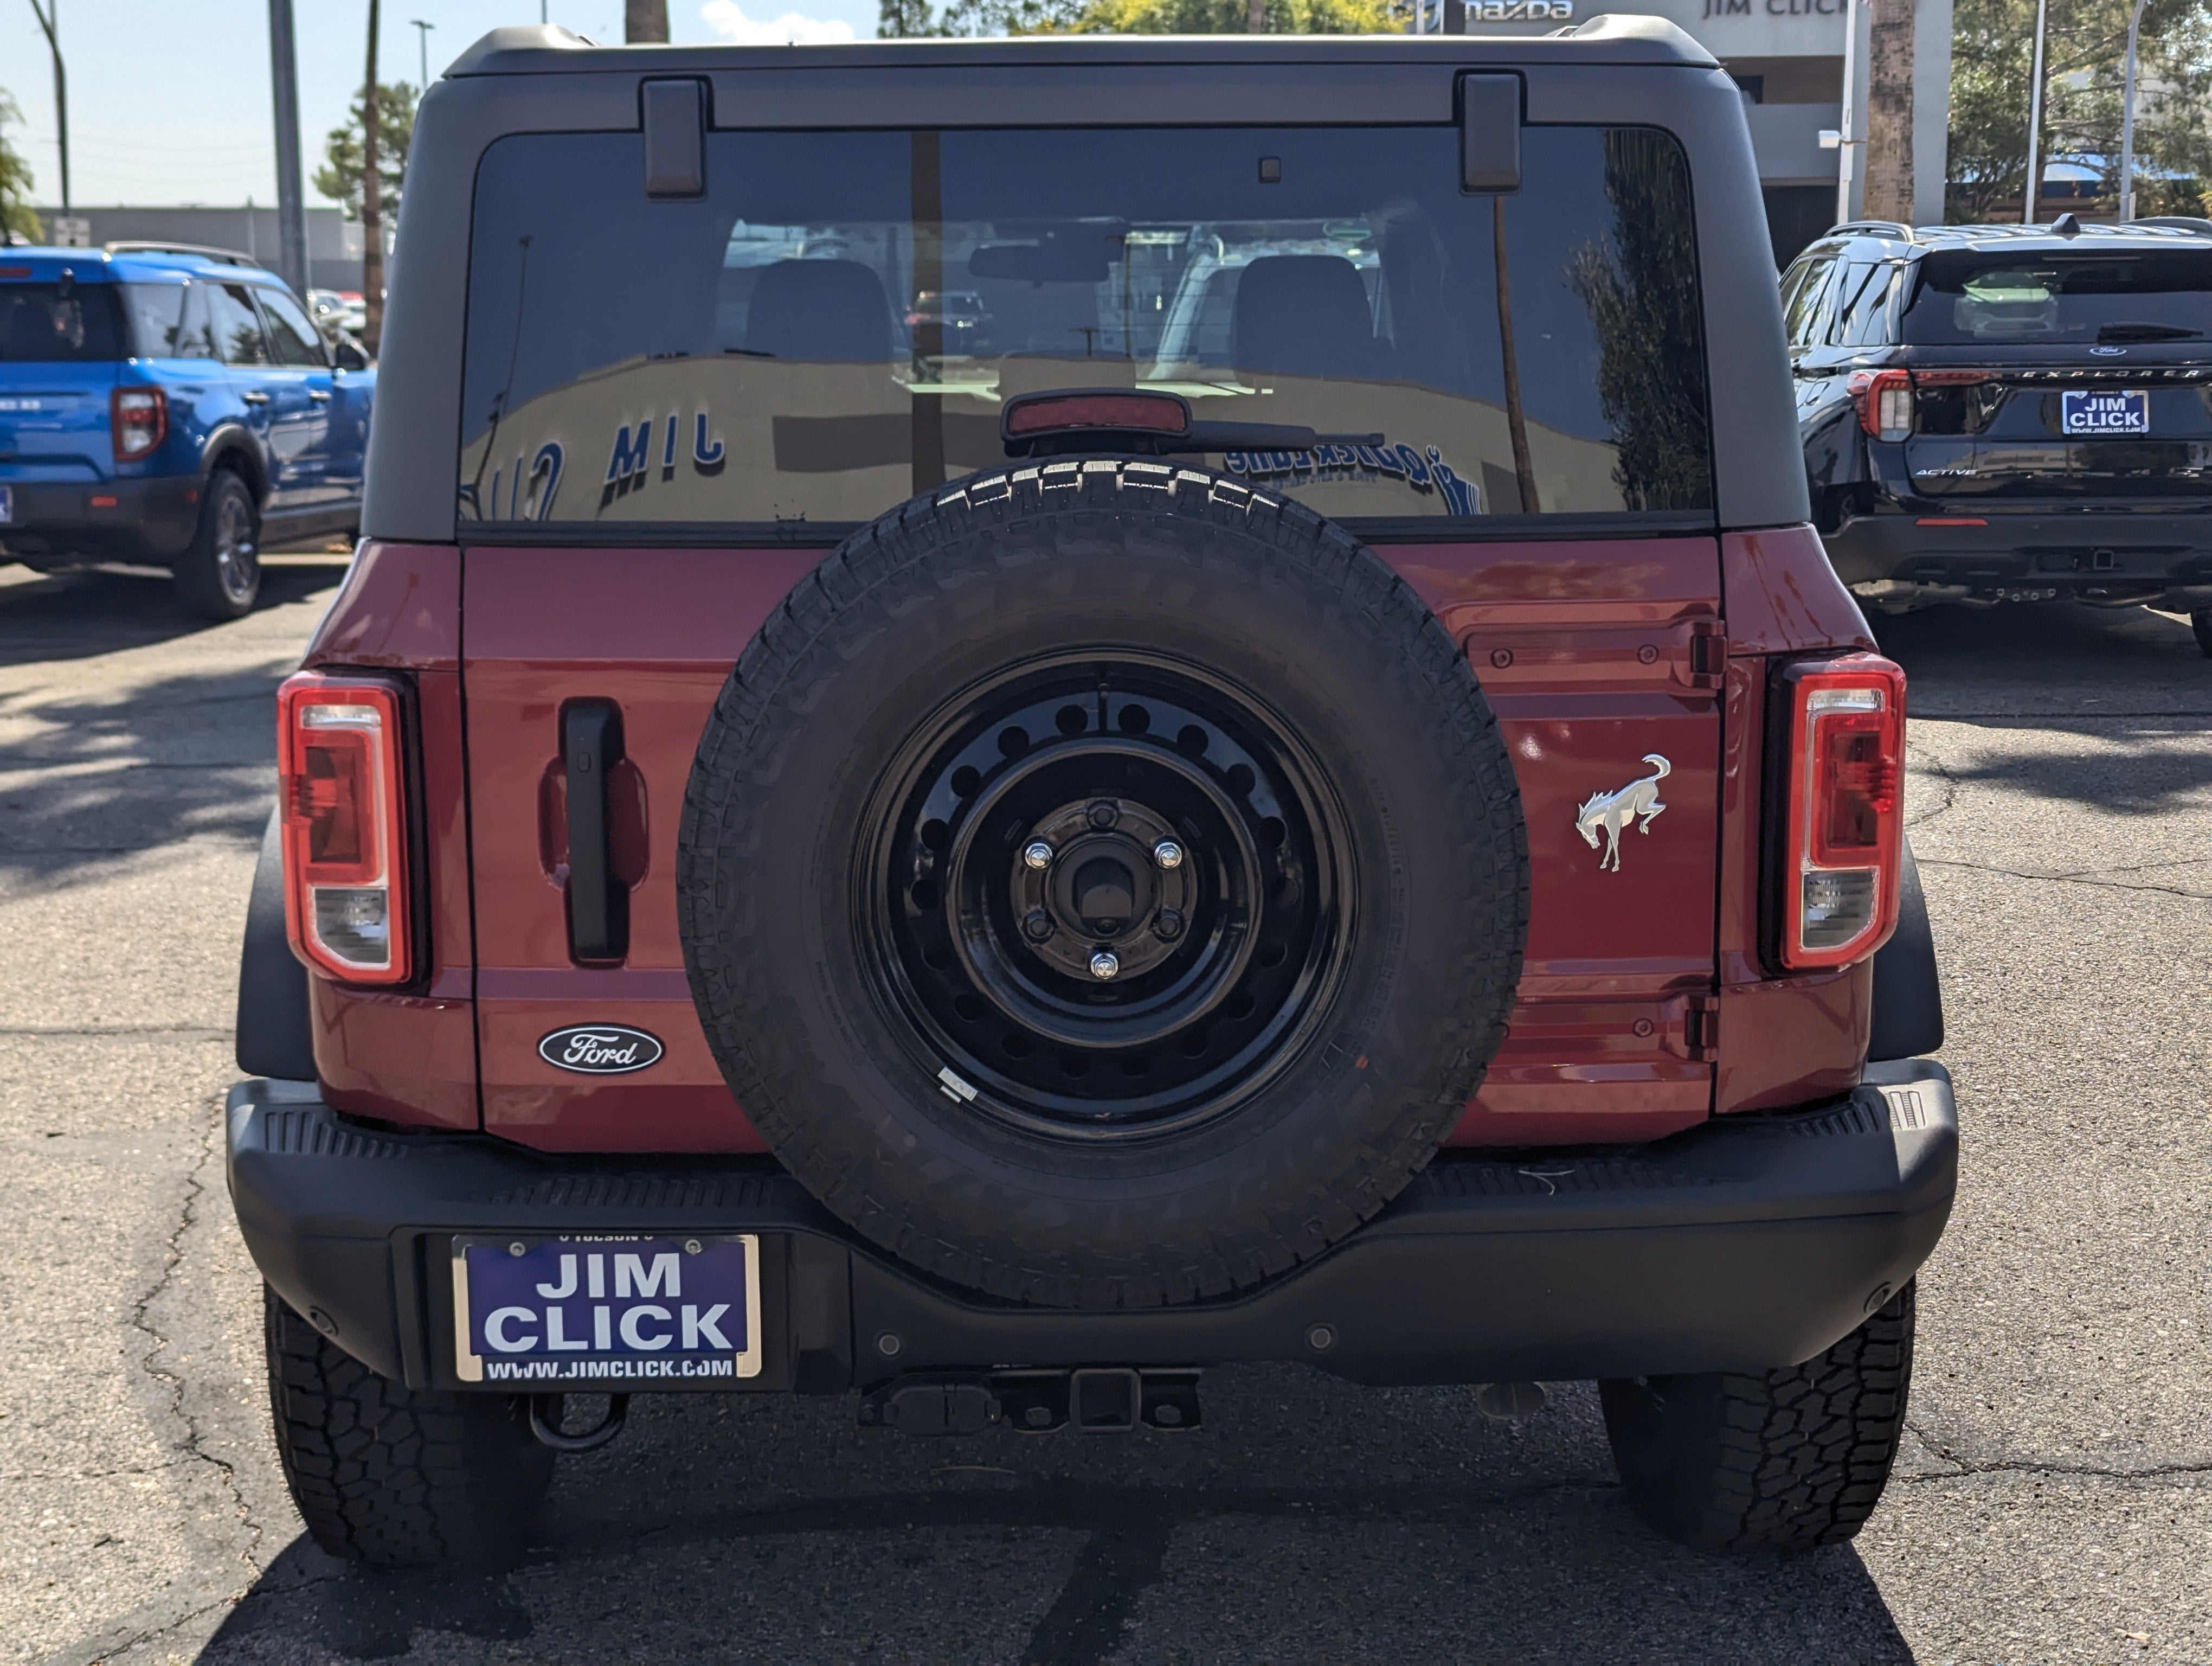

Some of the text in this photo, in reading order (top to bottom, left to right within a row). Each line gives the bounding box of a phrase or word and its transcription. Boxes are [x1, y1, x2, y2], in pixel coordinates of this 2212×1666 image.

[1702, 0, 1751, 20] JIM
[2022, 370, 2200, 378] EXPLORER
[2085, 398, 2126, 411] JIM
[2070, 412, 2140, 426] CLICK
[563, 1034, 639, 1064] Ford
[536, 1253, 681, 1299] JIM
[484, 1303, 733, 1352] CLICK
[487, 1359, 732, 1379] WWW.JIMCLICK.COM
